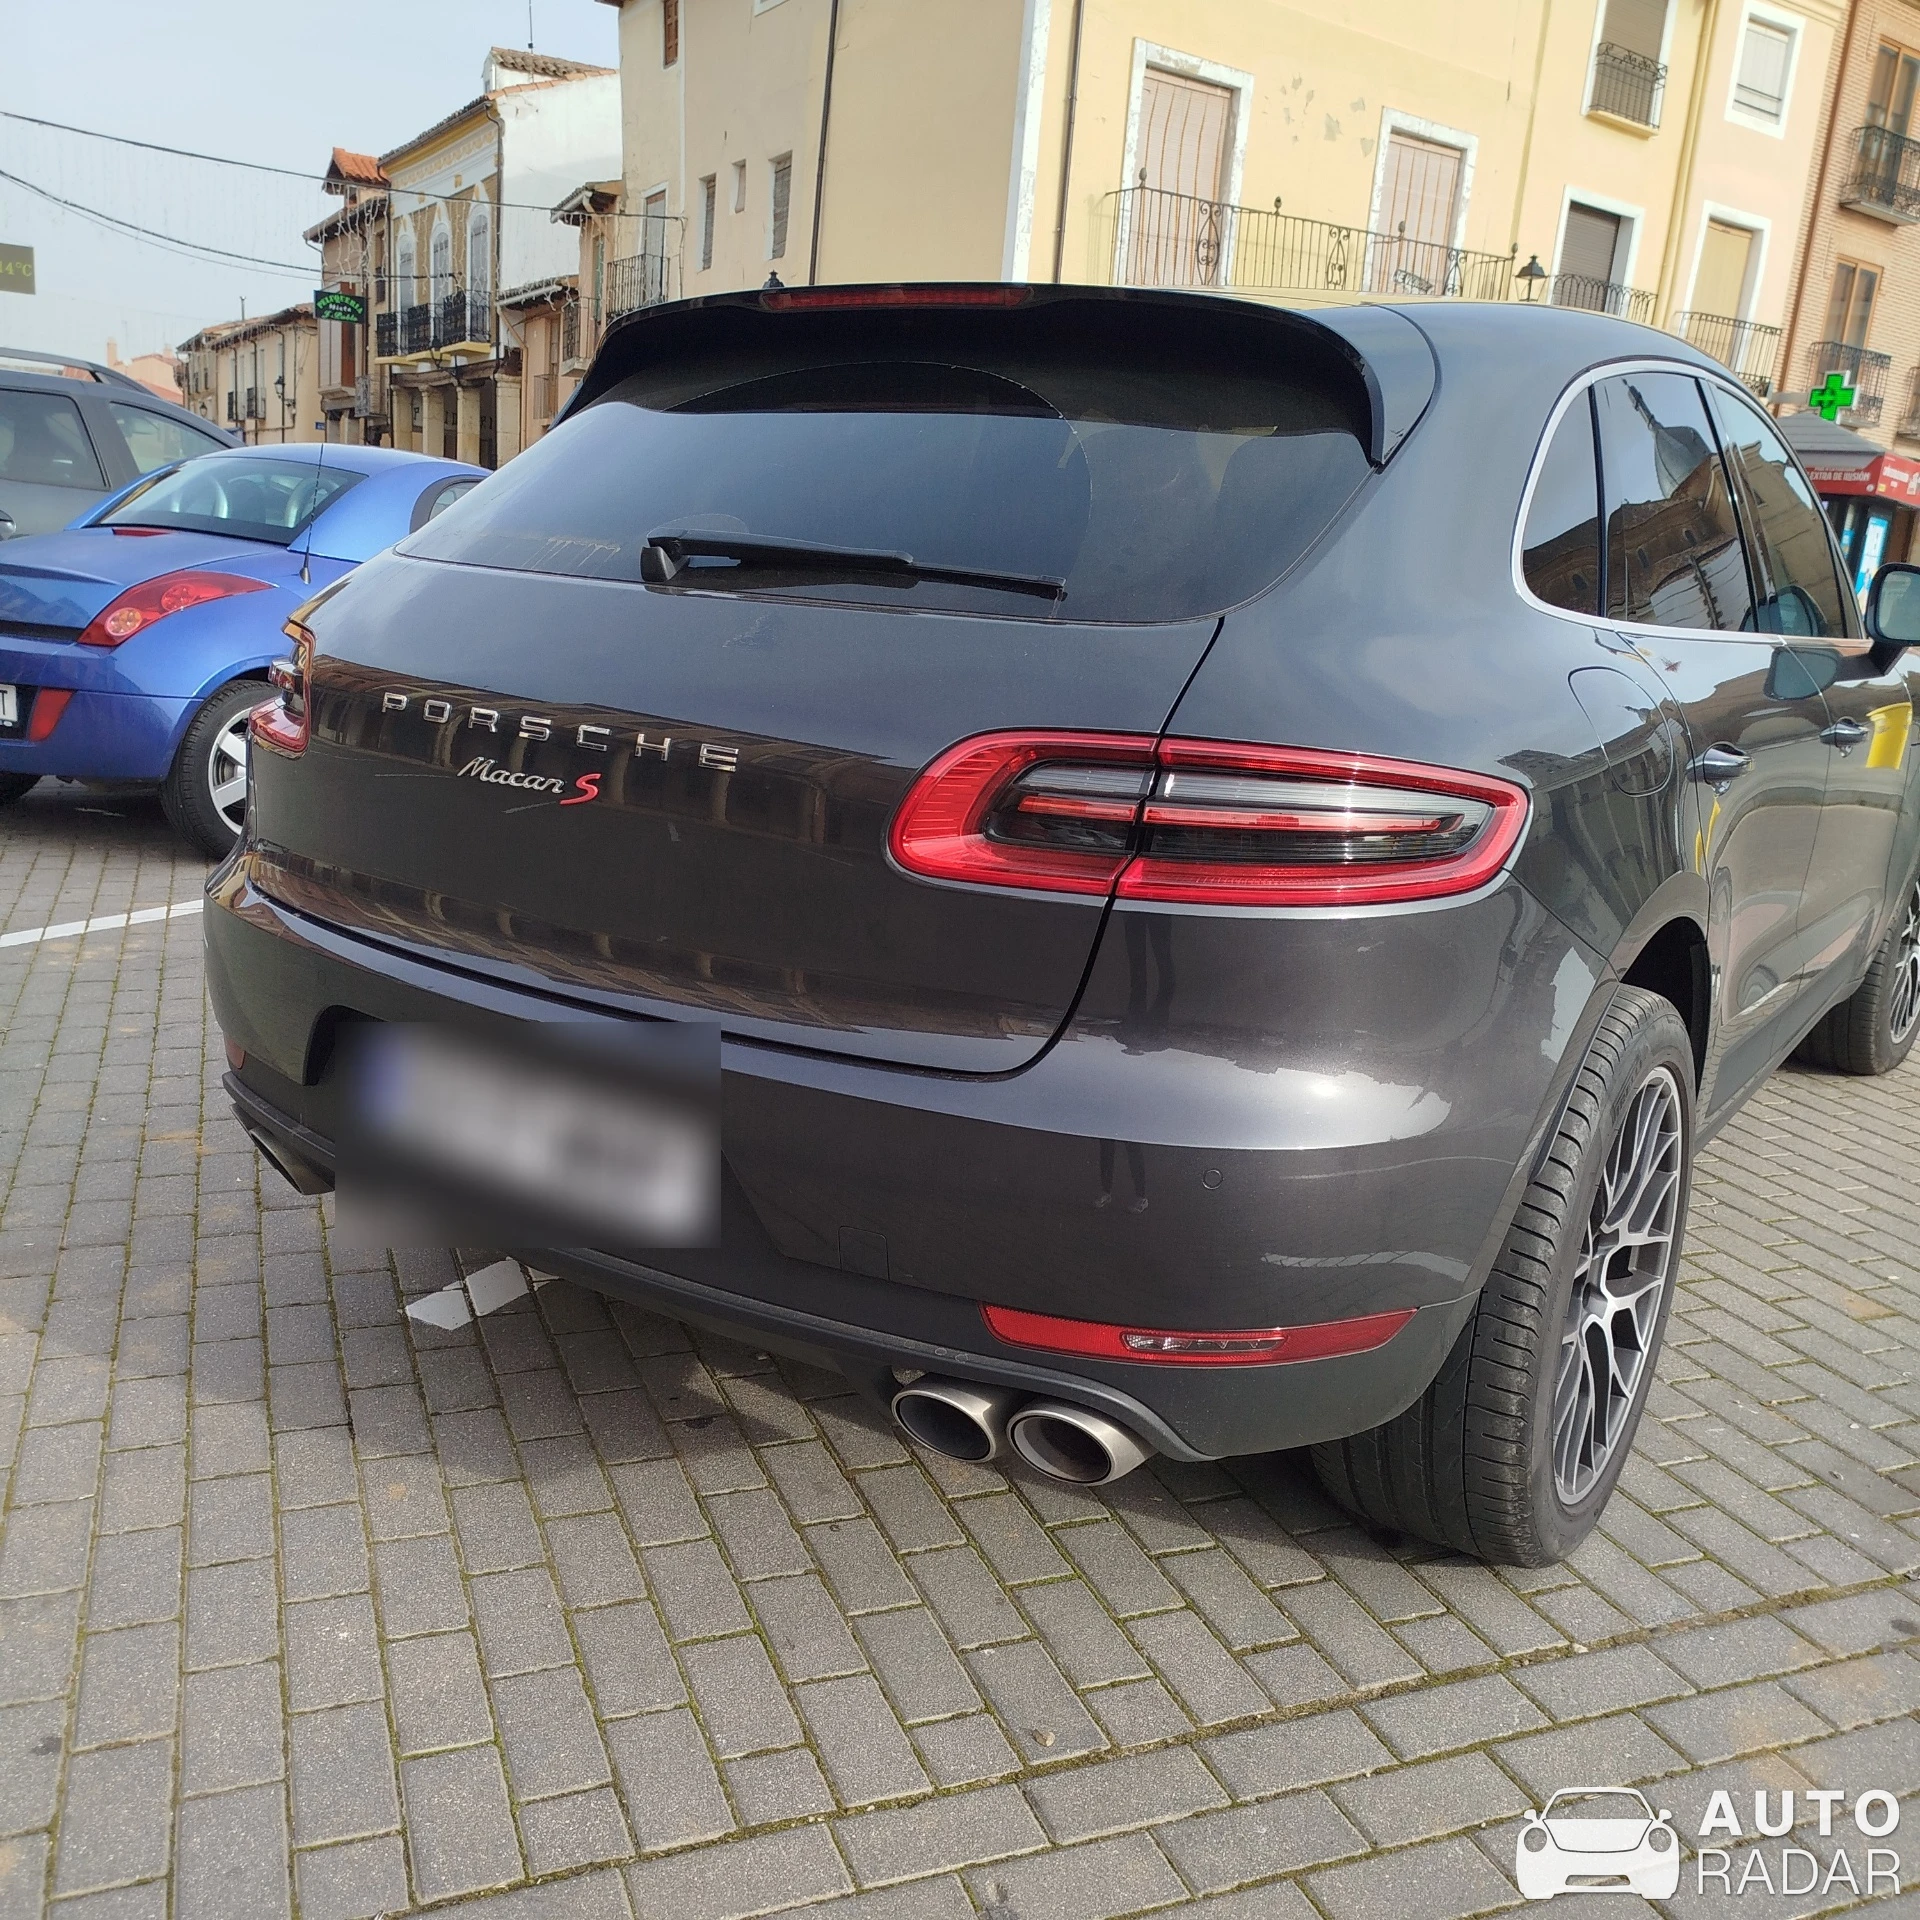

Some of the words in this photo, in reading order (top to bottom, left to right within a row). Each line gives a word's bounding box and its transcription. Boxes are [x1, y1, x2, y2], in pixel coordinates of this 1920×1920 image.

[381, 691, 740, 773] PORSCHE
[457, 756, 569, 794] Macan
[559, 772, 602, 805] S
